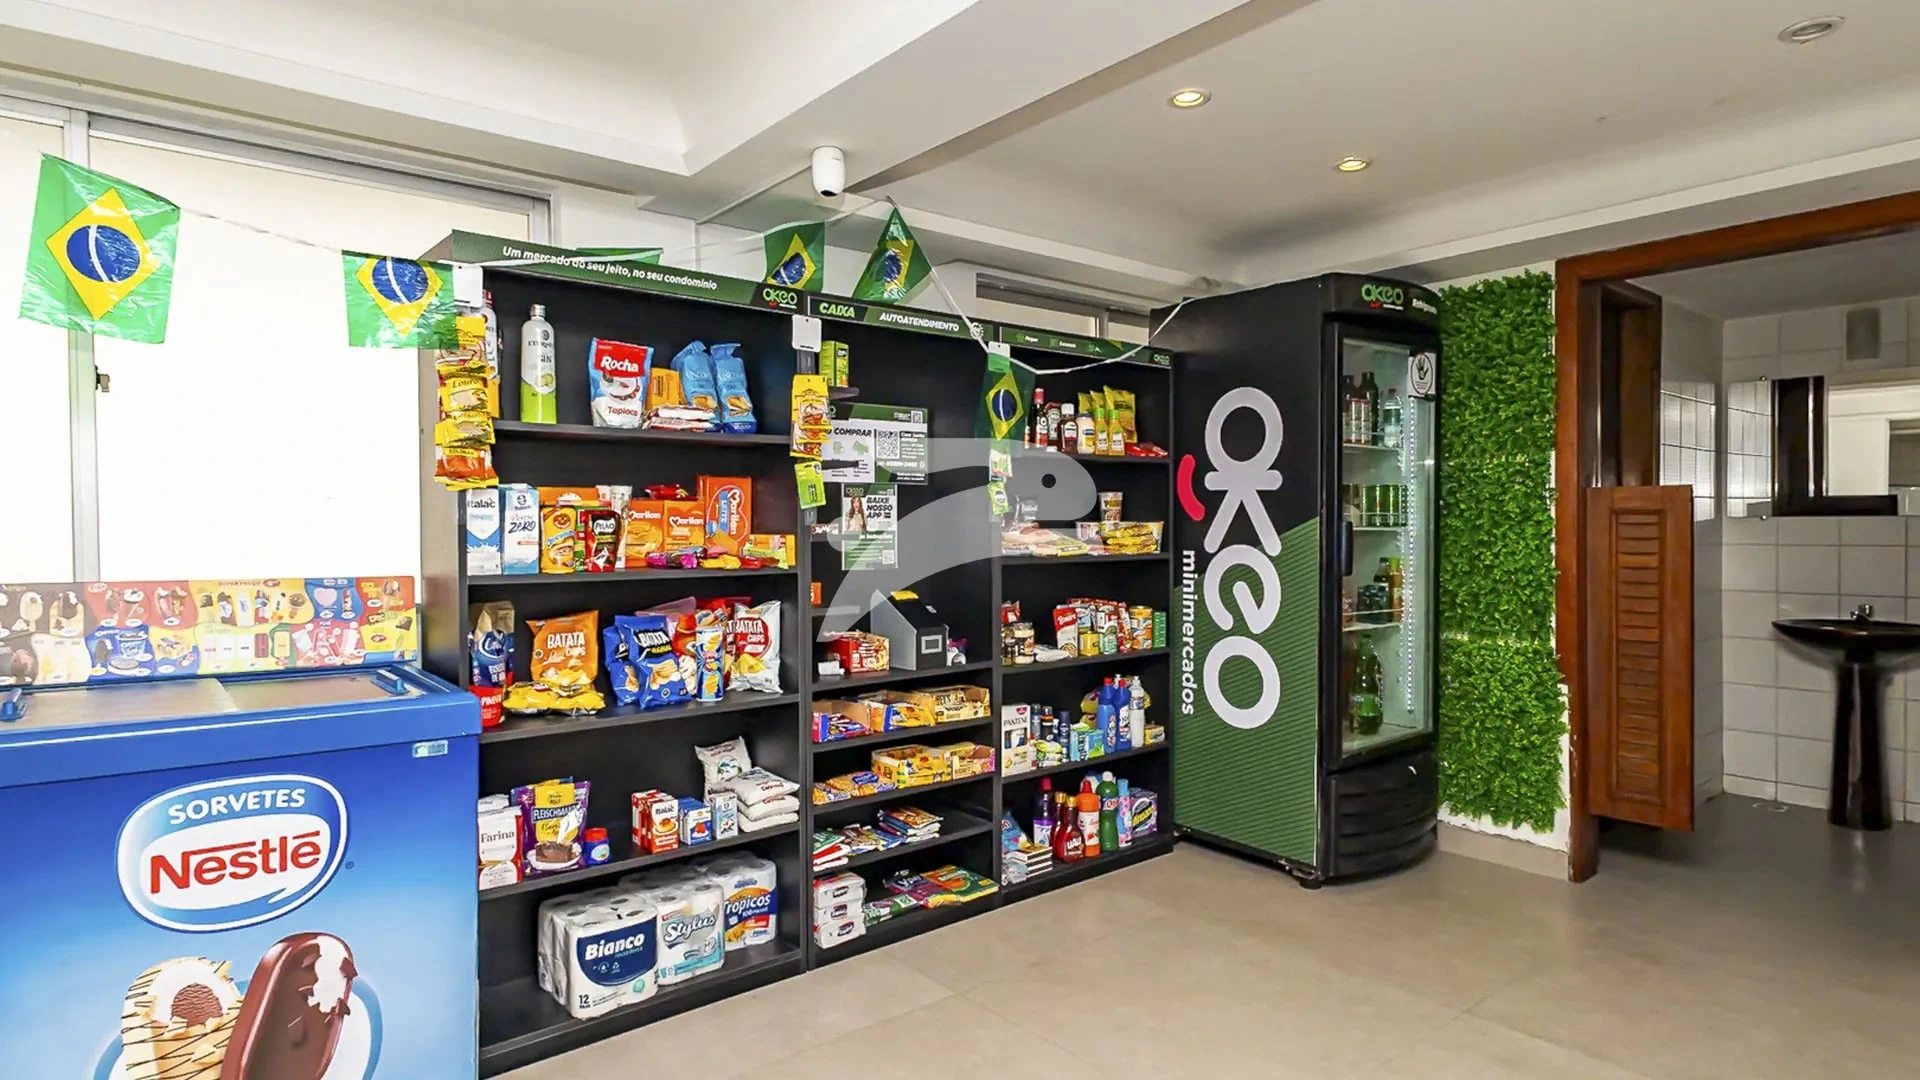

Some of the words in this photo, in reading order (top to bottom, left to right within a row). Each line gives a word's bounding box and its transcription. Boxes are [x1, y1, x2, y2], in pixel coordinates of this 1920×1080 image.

[502, 246, 521, 257] Um
[523, 250, 571, 266] mercado
[572, 256, 586, 268] do
[587, 261, 605, 272] seu
[605, 263, 632, 278] jeito,
[632, 268, 646, 279] no
[646, 271, 664, 282] seu
[819, 302, 856, 318] CAIXA
[879, 312, 960, 332] AUTOATENDIMENTO
[600, 356, 639, 372] Rocha
[607, 406, 639, 417] Tapioca
[834, 427, 873, 438] COMPRAR
[728, 488, 741, 535] Marilan
[866, 504, 893, 512] NOSSO
[734, 619, 764, 635] BATATA
[1181, 550, 1198, 715] minimercados
[547, 631, 586, 650] BATATA
[638, 631, 670, 648] BATATA
[167, 788, 307, 825] SORVETES
[480, 830, 515, 843] Farina
[150, 830, 321, 894] Nestlé
[725, 894, 771, 915] Tropicos
[663, 914, 717, 942] Stylus
[584, 933, 645, 961] Bianco
[579, 994, 590, 1004] 12
